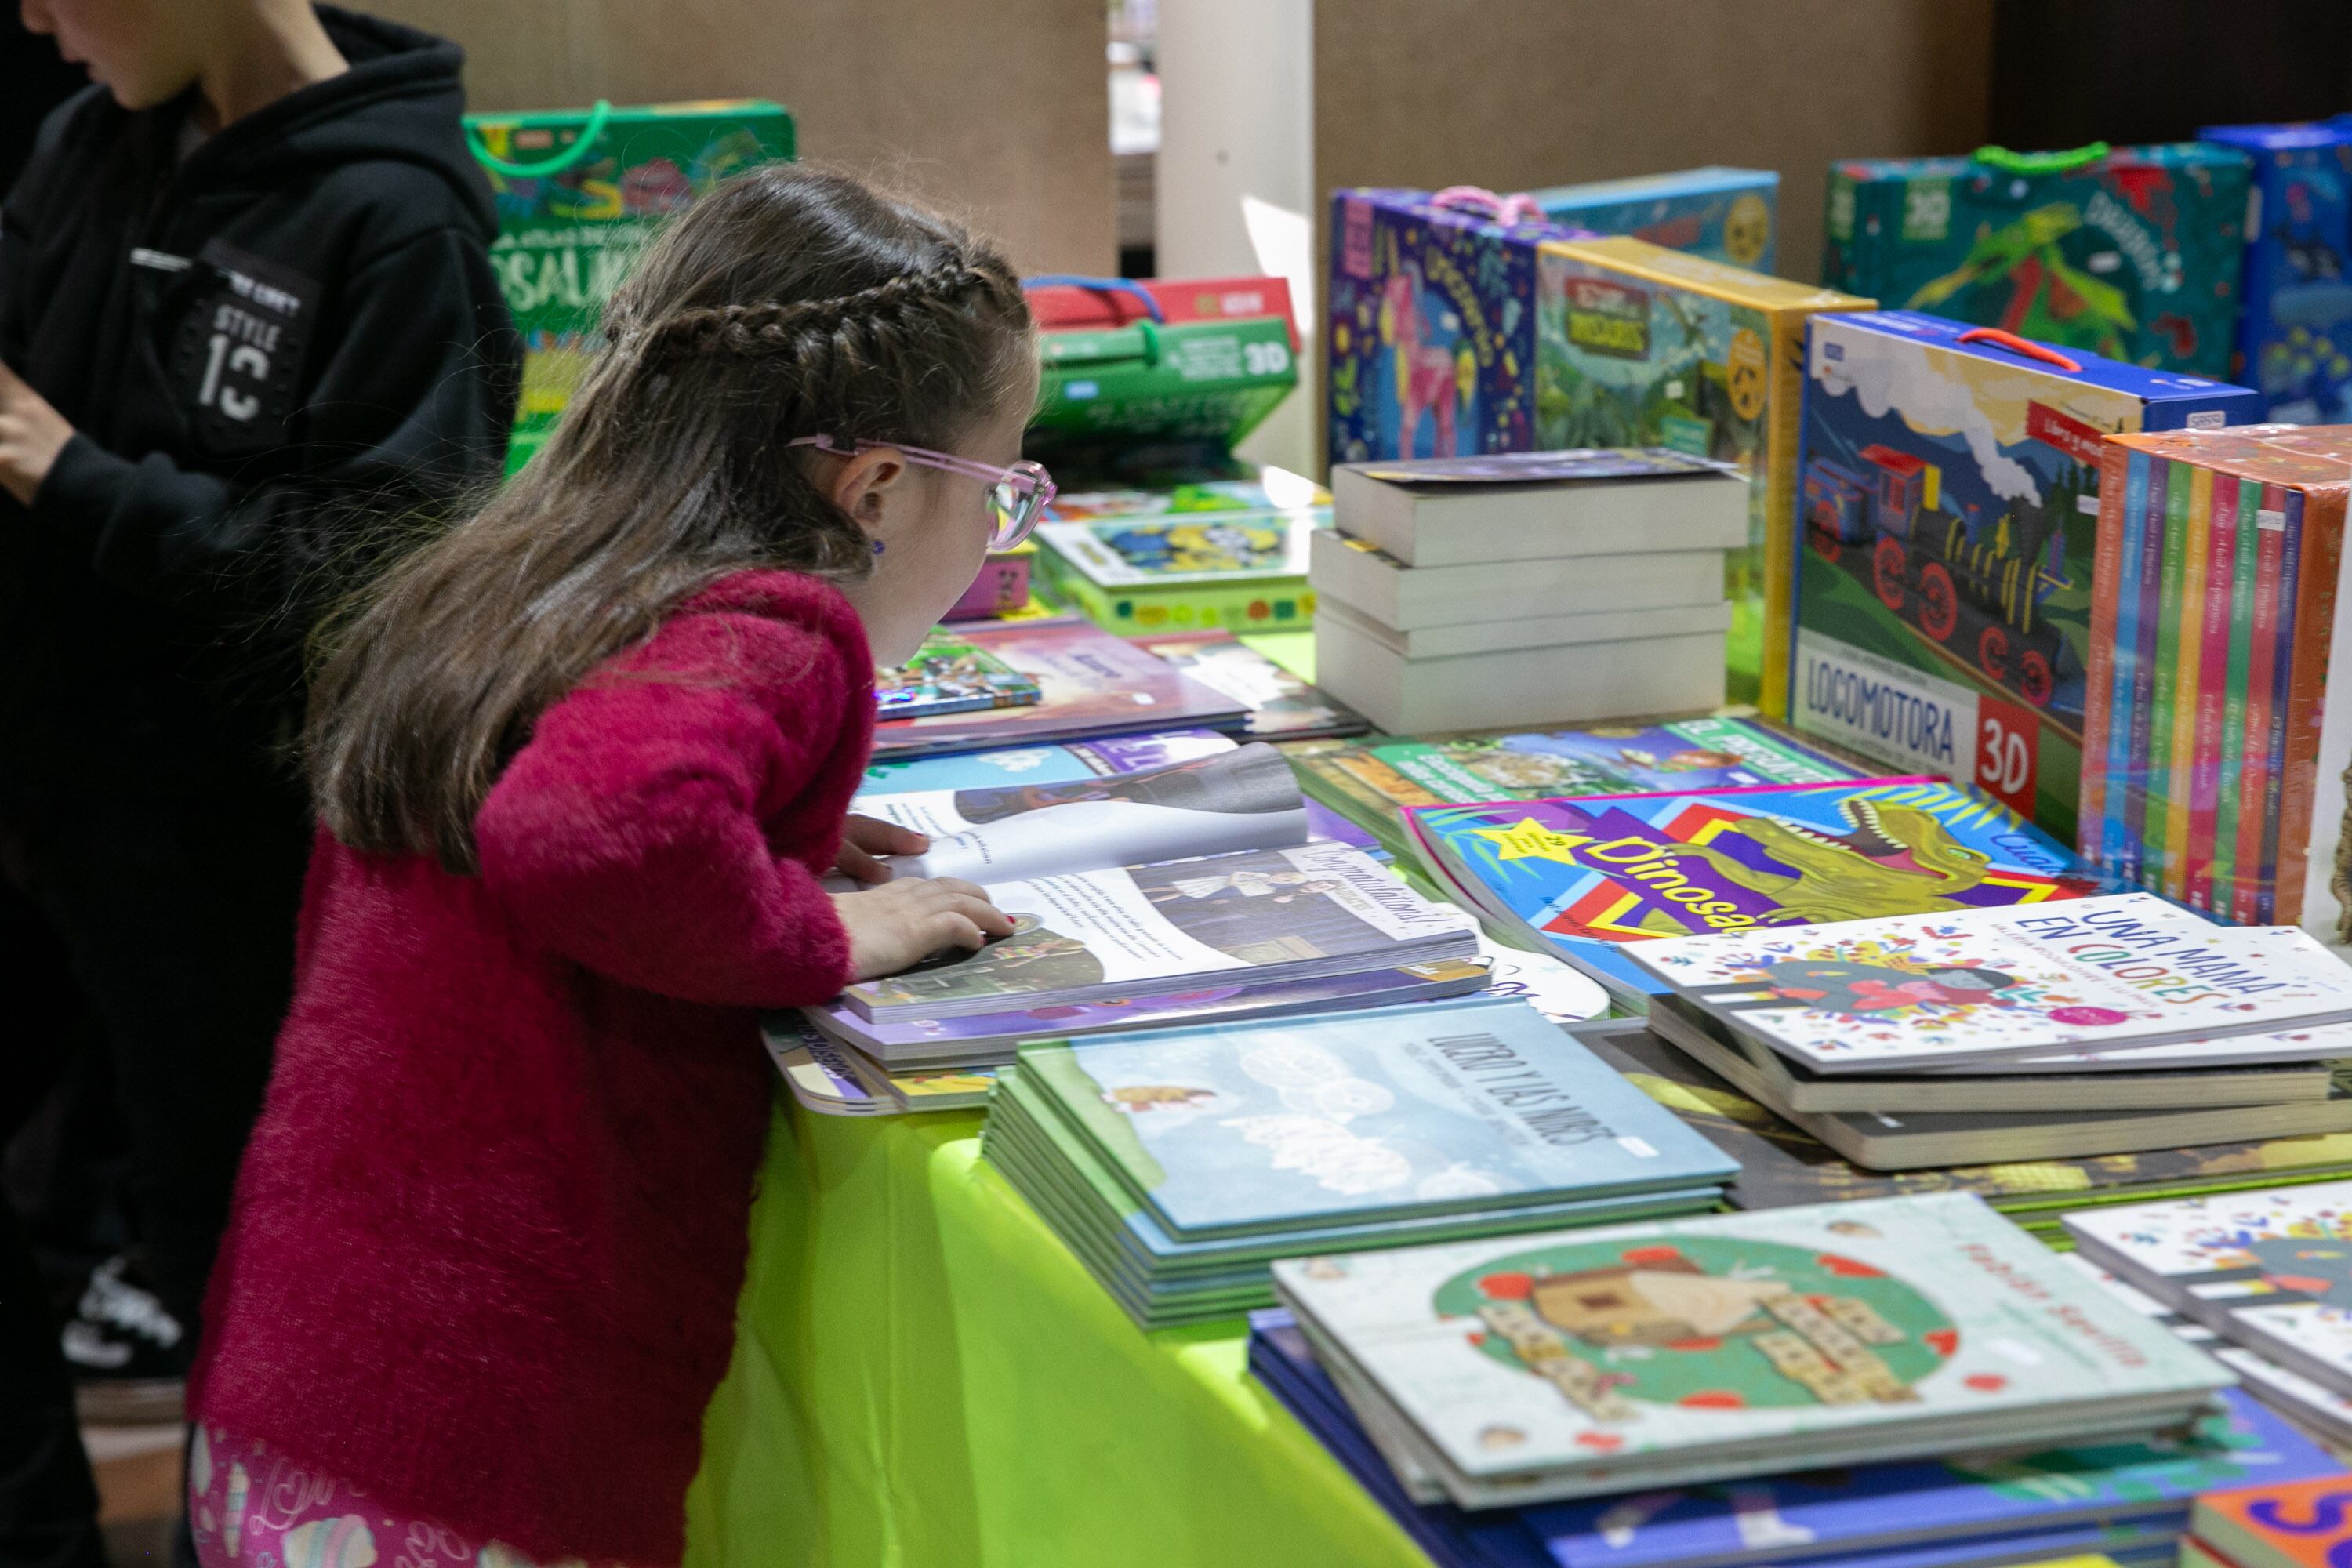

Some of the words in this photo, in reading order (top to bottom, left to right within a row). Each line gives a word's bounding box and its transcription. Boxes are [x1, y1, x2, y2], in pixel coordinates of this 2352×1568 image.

[214, 304, 281, 354] STYLE
[1808, 657, 1955, 765] LOCOMOTORA
[1980, 717, 2028, 794] 3D
[1304, 851, 1455, 924] Congratulations!
[2081, 910, 2181, 949] UNA
[2015, 916, 2093, 939] EN
[2067, 943, 2232, 1004] COLORES
[1427, 1032, 1528, 1072] LUCERO
[1476, 1069, 1544, 1083] Y
[1486, 1081, 1571, 1108] LAS
